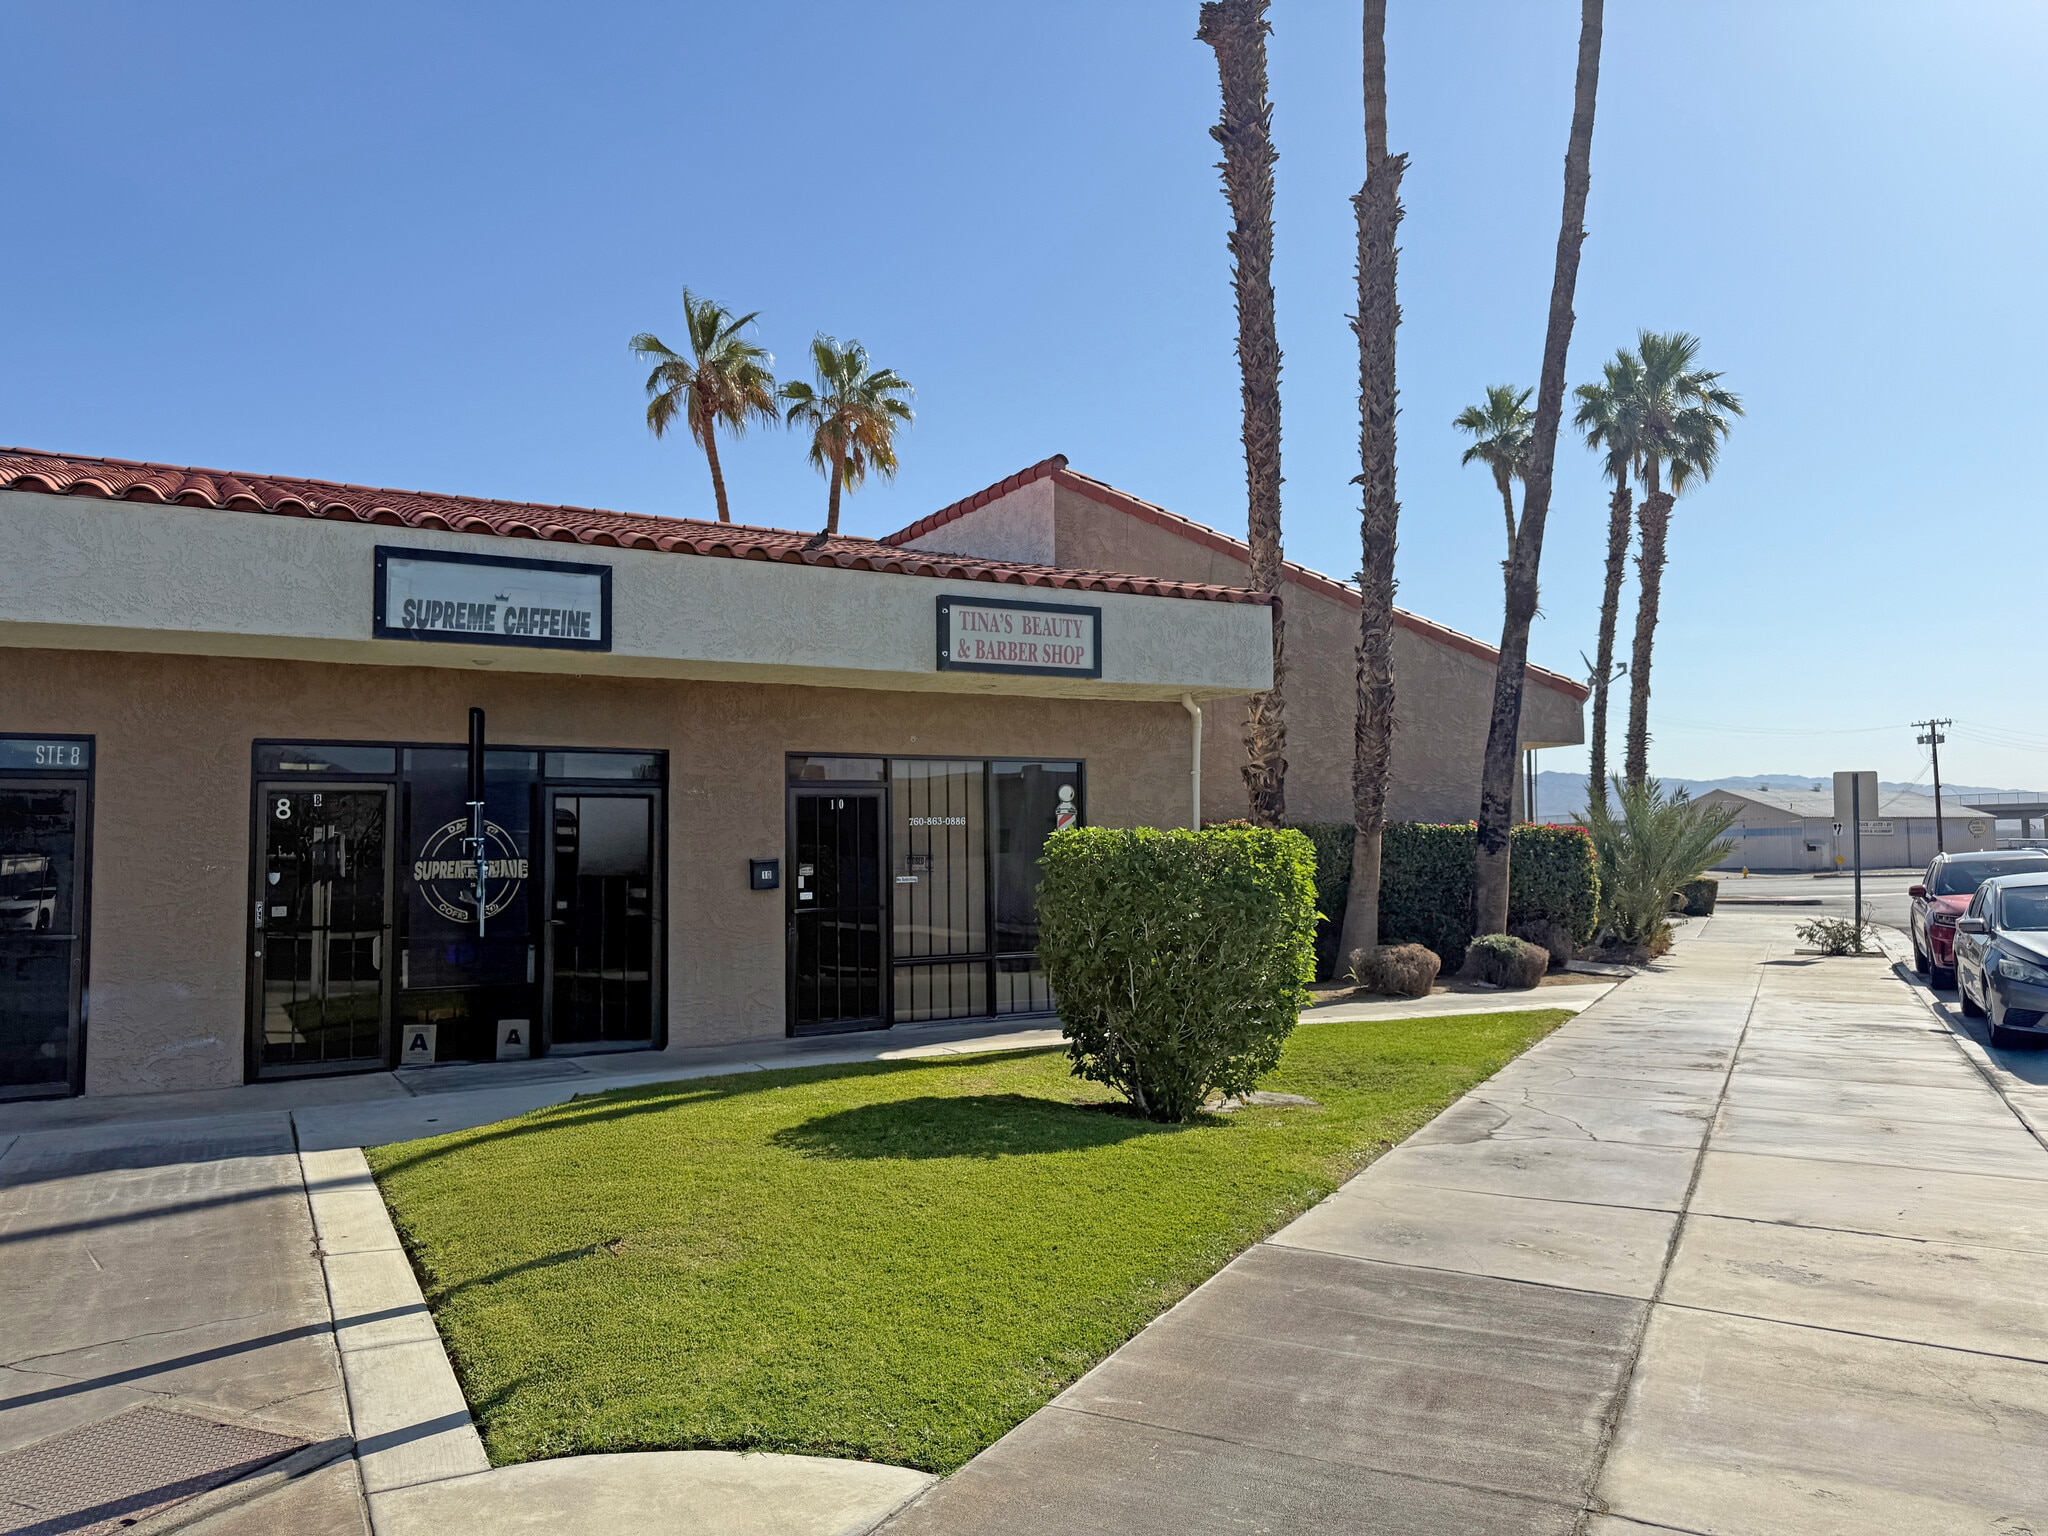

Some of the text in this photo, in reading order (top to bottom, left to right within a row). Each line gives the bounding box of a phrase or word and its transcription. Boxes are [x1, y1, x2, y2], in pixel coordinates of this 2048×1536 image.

[402, 599, 591, 638] SUPREME CAFFEINE
[958, 610, 1083, 638] TINA'S BEAUTY
[957, 638, 1085, 665] & BARBER SHOP
[35, 745, 80, 765] STE 8
[276, 798, 291, 819] 8
[909, 817, 966, 826] 760-863-0886
[906, 856, 925, 865] COSED
[409, 1033, 428, 1051] A
[505, 1029, 521, 1044] A
